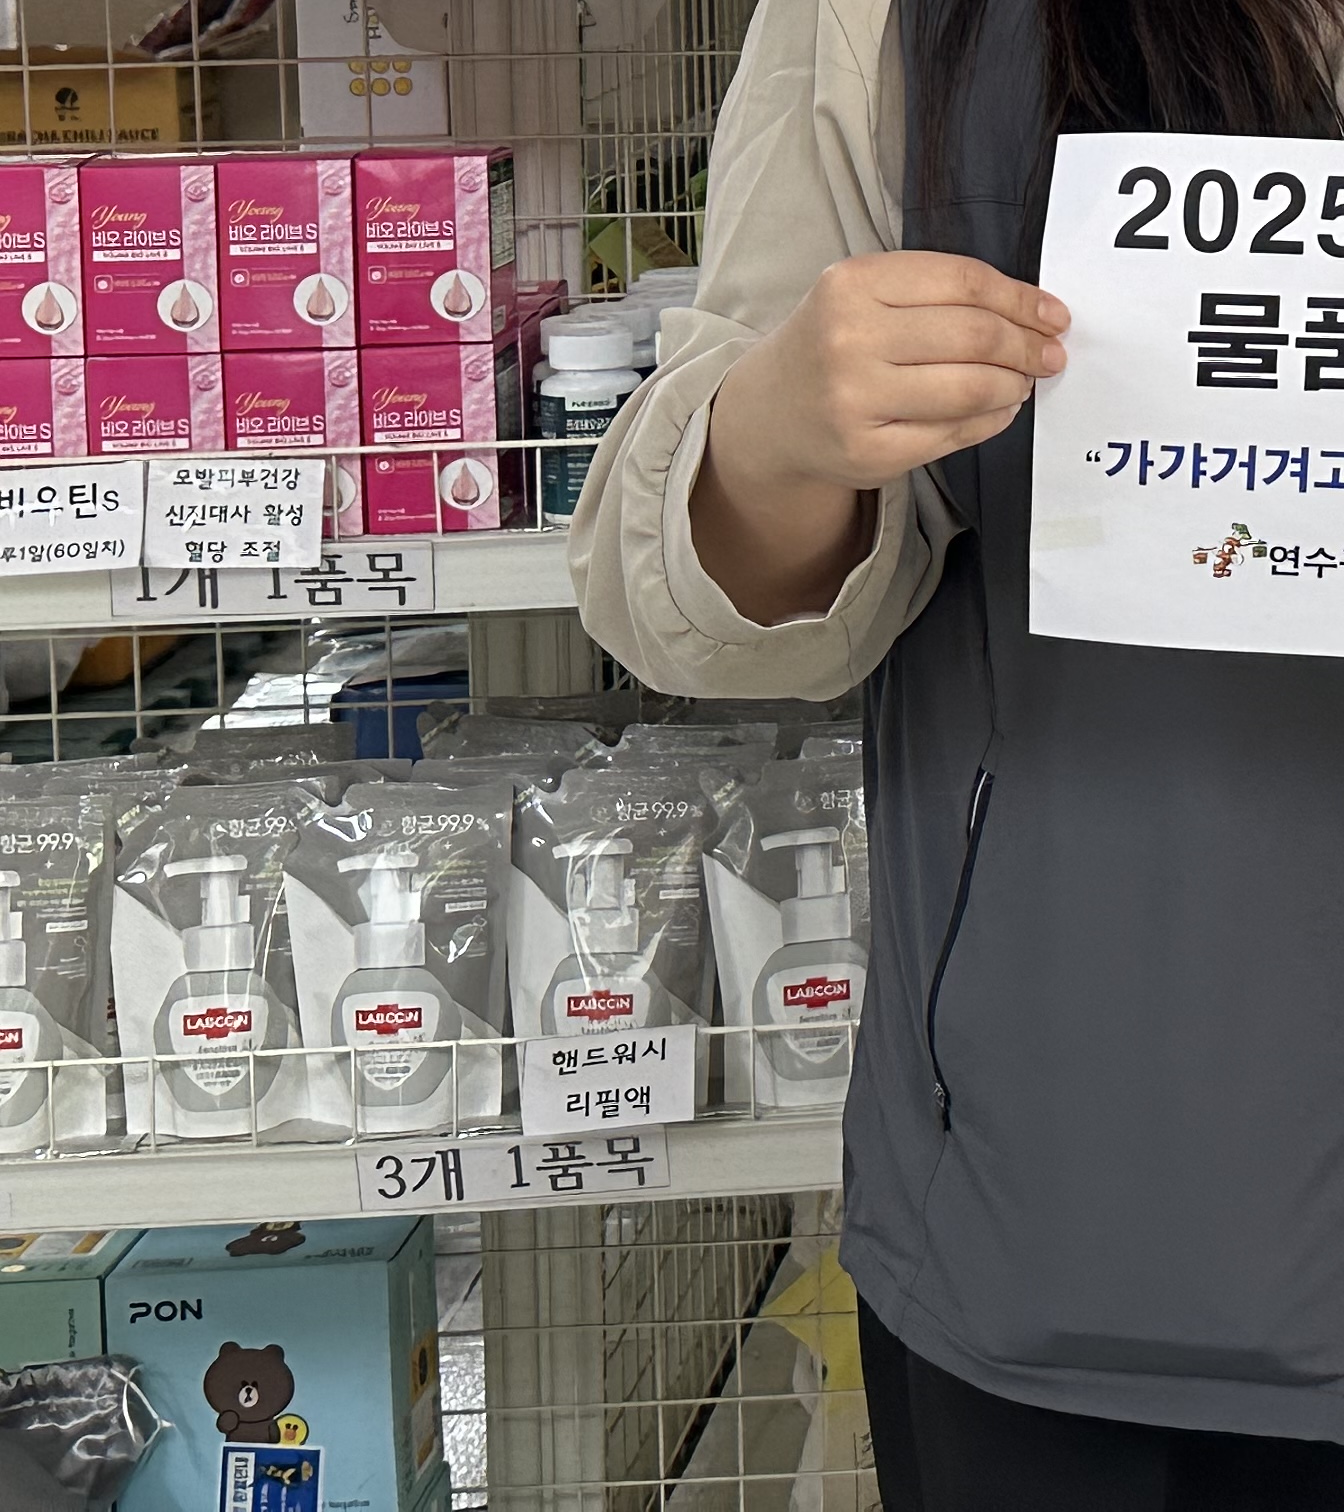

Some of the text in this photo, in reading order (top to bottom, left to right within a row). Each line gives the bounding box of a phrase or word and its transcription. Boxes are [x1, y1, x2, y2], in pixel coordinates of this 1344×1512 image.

[172, 468, 301, 490] 모발피부건강
[552, 1038, 668, 1076] 핸드워시
[566, 1085, 652, 1120] 리필액
[375, 1136, 655, 1201] 3개 1품목
